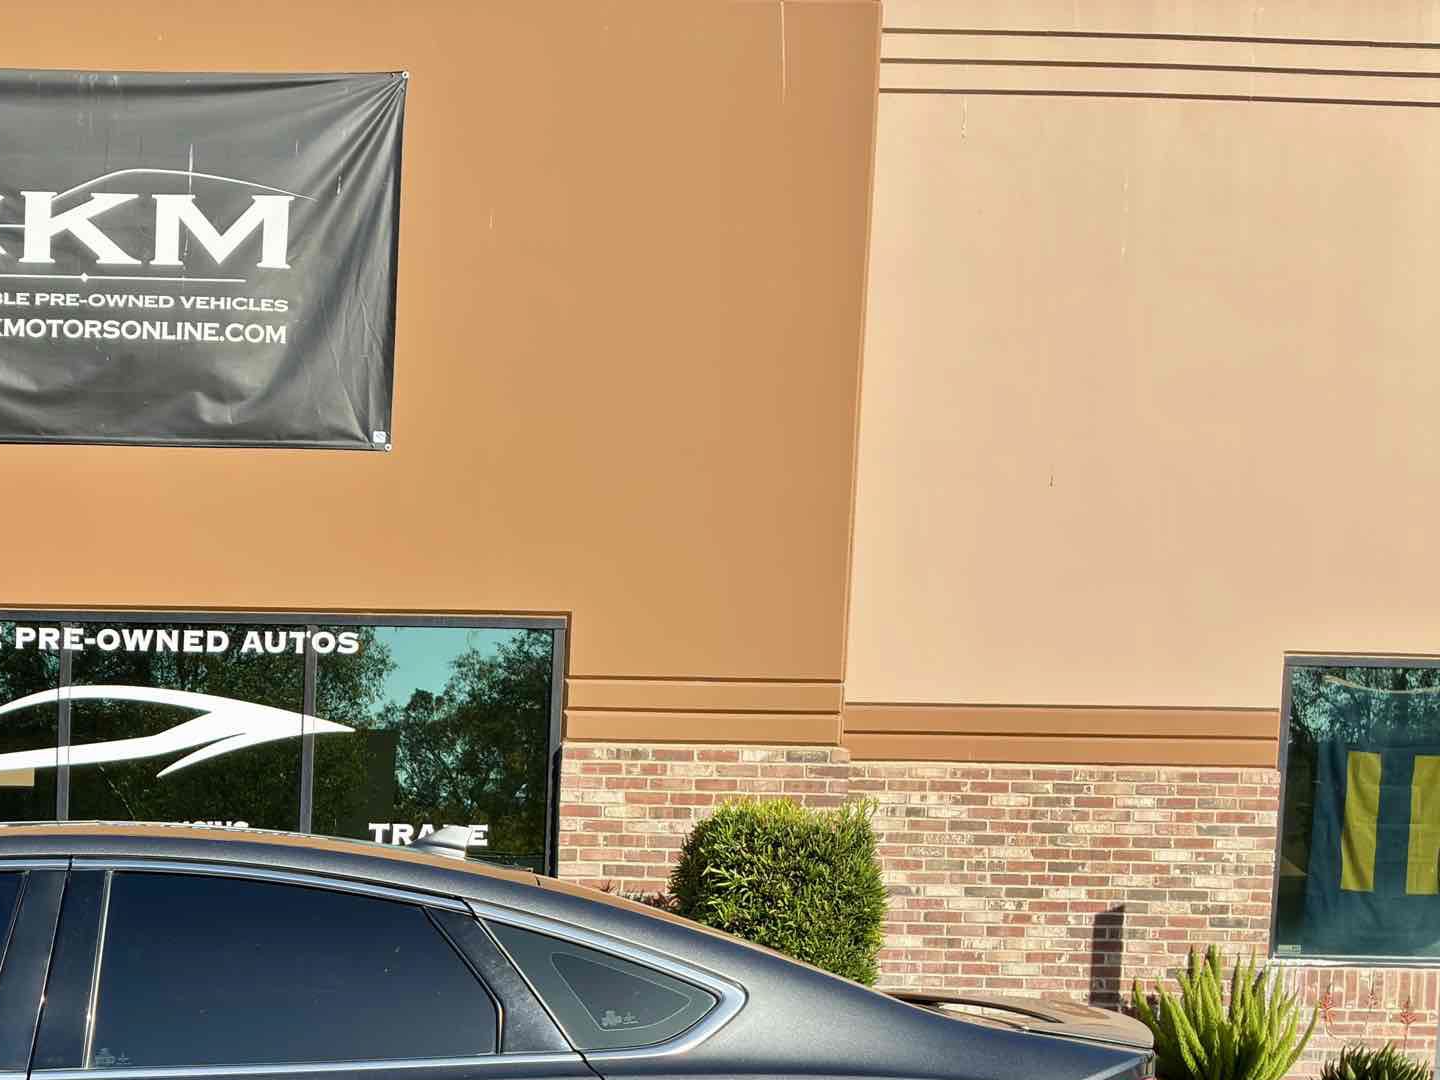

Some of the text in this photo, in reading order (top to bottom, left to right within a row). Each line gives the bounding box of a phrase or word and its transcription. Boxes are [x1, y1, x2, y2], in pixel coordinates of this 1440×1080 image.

[35, 292, 175, 309] PRE-OWNED
[179, 296, 289, 312] VEHICLES
[15, 626, 230, 653] PRE-OWNED
[240, 630, 360, 655] AUTOS
[368, 822, 488, 847] TRAE
